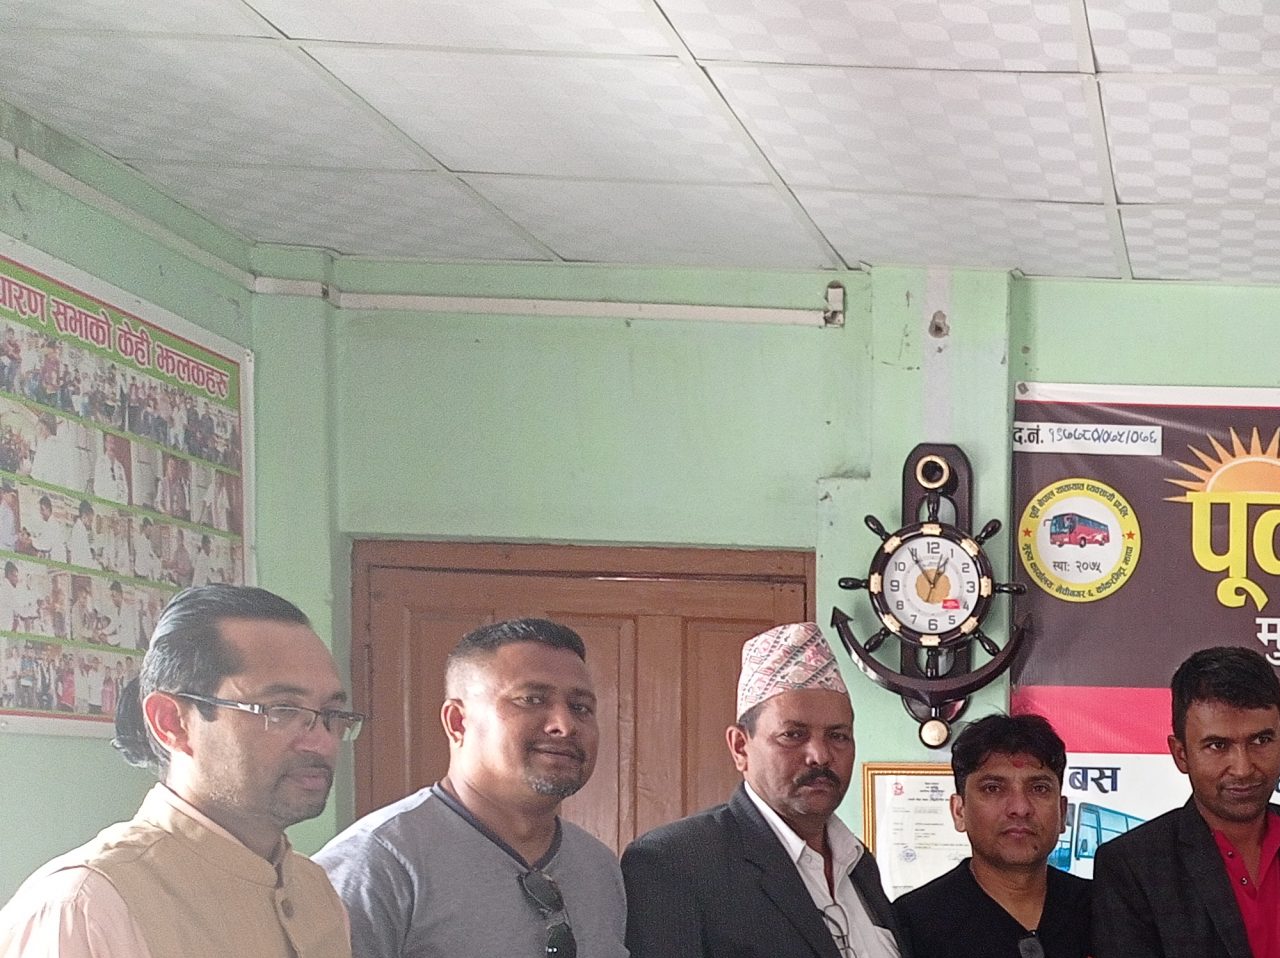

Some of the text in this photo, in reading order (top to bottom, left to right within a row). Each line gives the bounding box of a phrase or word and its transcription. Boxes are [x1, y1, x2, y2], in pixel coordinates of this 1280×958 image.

[0, 276, 46, 323] ारण
[51, 297, 113, 350] सभाको
[117, 319, 151, 367] केही
[926, 541, 940, 555] 12
[895, 562, 906, 572] 10
[961, 562, 970, 573] 2
[890, 580, 899, 592] 9
[966, 581, 976, 593] 3
[896, 600, 904, 610] 8
[963, 601, 969, 611] 4
[910, 614, 917, 625] 7
[928, 619, 938, 631] 6
[948, 615, 956, 625] 5
[1068, 766, 1121, 794] बस
